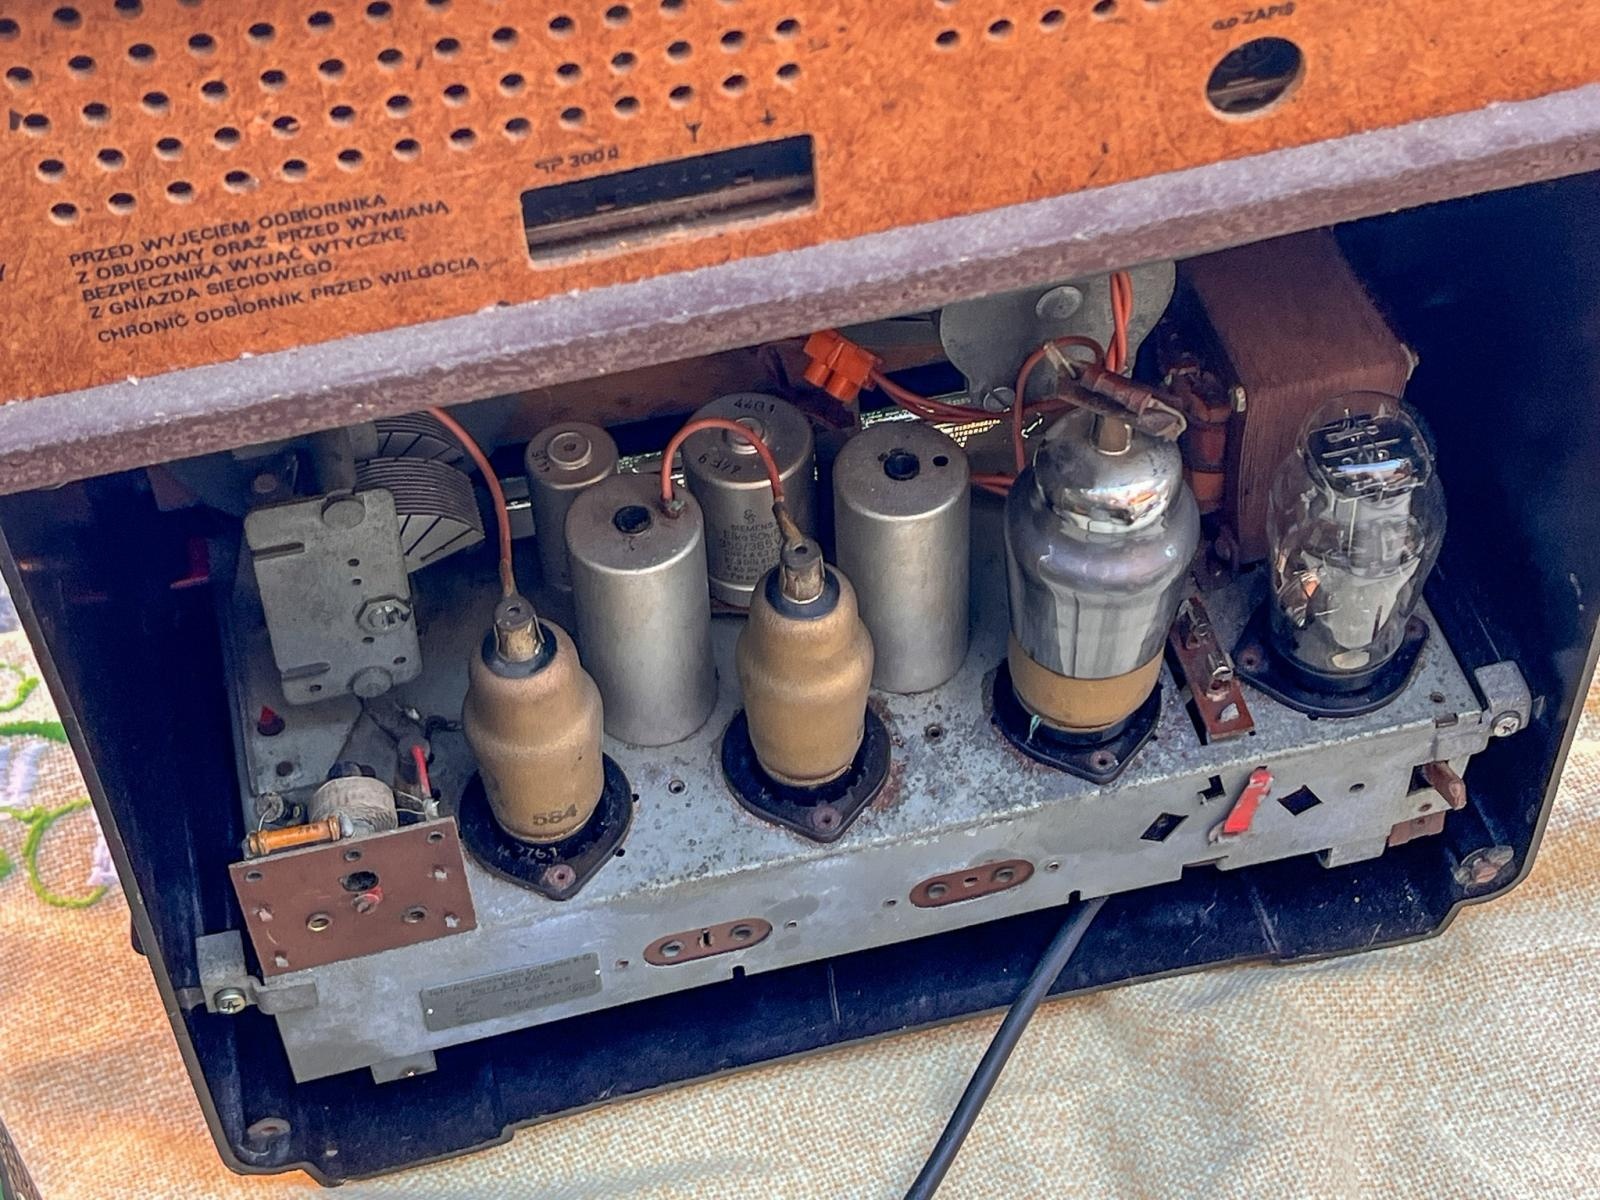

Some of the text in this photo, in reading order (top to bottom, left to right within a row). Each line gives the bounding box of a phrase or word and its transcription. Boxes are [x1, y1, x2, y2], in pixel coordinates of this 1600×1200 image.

[1241, 2, 1296, 24] ZAPIS
[569, 148, 604, 168] 300
[69, 243, 134, 267] PRZED
[258, 194, 388, 229] ODBIORNIKA
[76, 271, 89, 285] Z
[96, 249, 204, 280] OBUDOWY
[213, 235, 267, 257] ORAZ
[277, 222, 340, 244] PRZED
[82, 264, 222, 303] BEZPIECZNIKA
[195, 291, 305, 324] ODBIORNIK
[311, 277, 373, 300] PRZED
[90, 306, 103, 320] Z
[109, 287, 200, 315] GNIAZDA
[533, 803, 578, 826] 584
